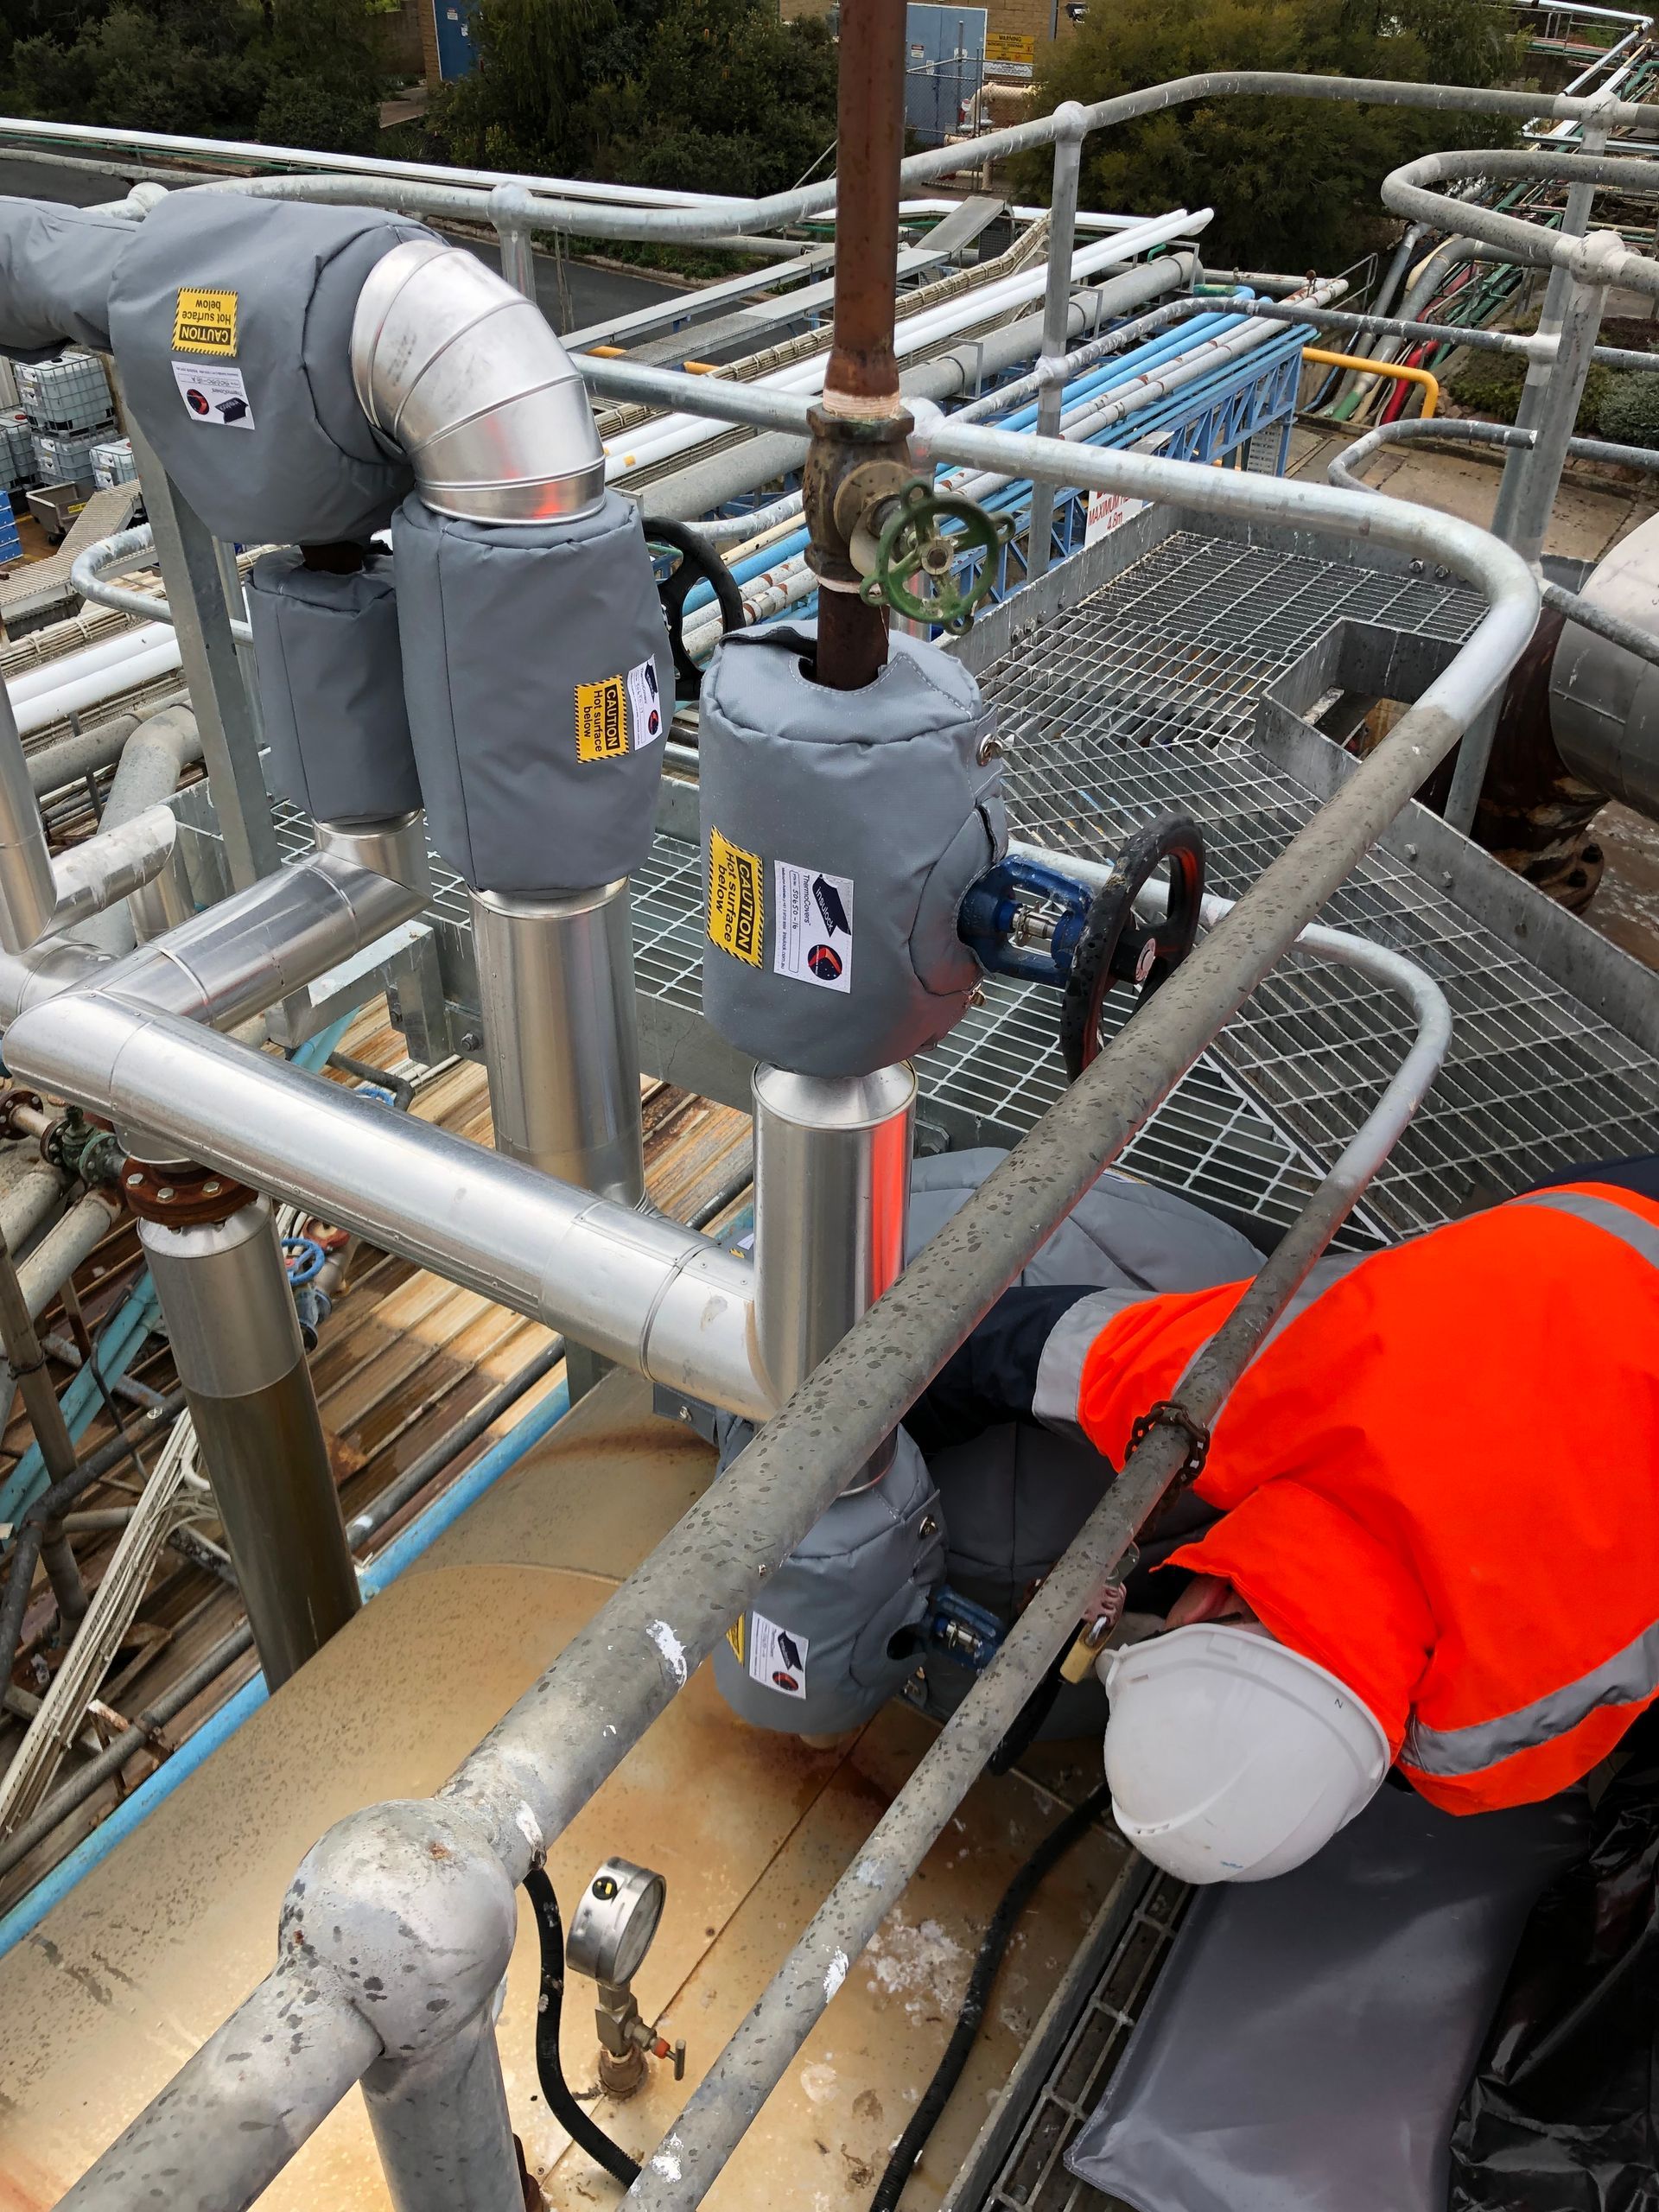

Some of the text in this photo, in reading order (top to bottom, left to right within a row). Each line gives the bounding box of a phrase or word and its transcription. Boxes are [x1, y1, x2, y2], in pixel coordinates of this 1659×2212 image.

[182, 310, 232, 326] Hot surface
[195, 299, 221, 312] below
[181, 326, 229, 343] CAUTION
[1088, 494, 1119, 527] MAXIMUM
[583, 706, 593, 738] below
[594, 690, 603, 753] Hot surface
[607, 690, 618, 747] CAUTION
[715, 863, 728, 914] below
[724, 850, 736, 943] Hot surface
[739, 864, 753, 951] CAUTION
[815, 886, 836, 932] insulock
